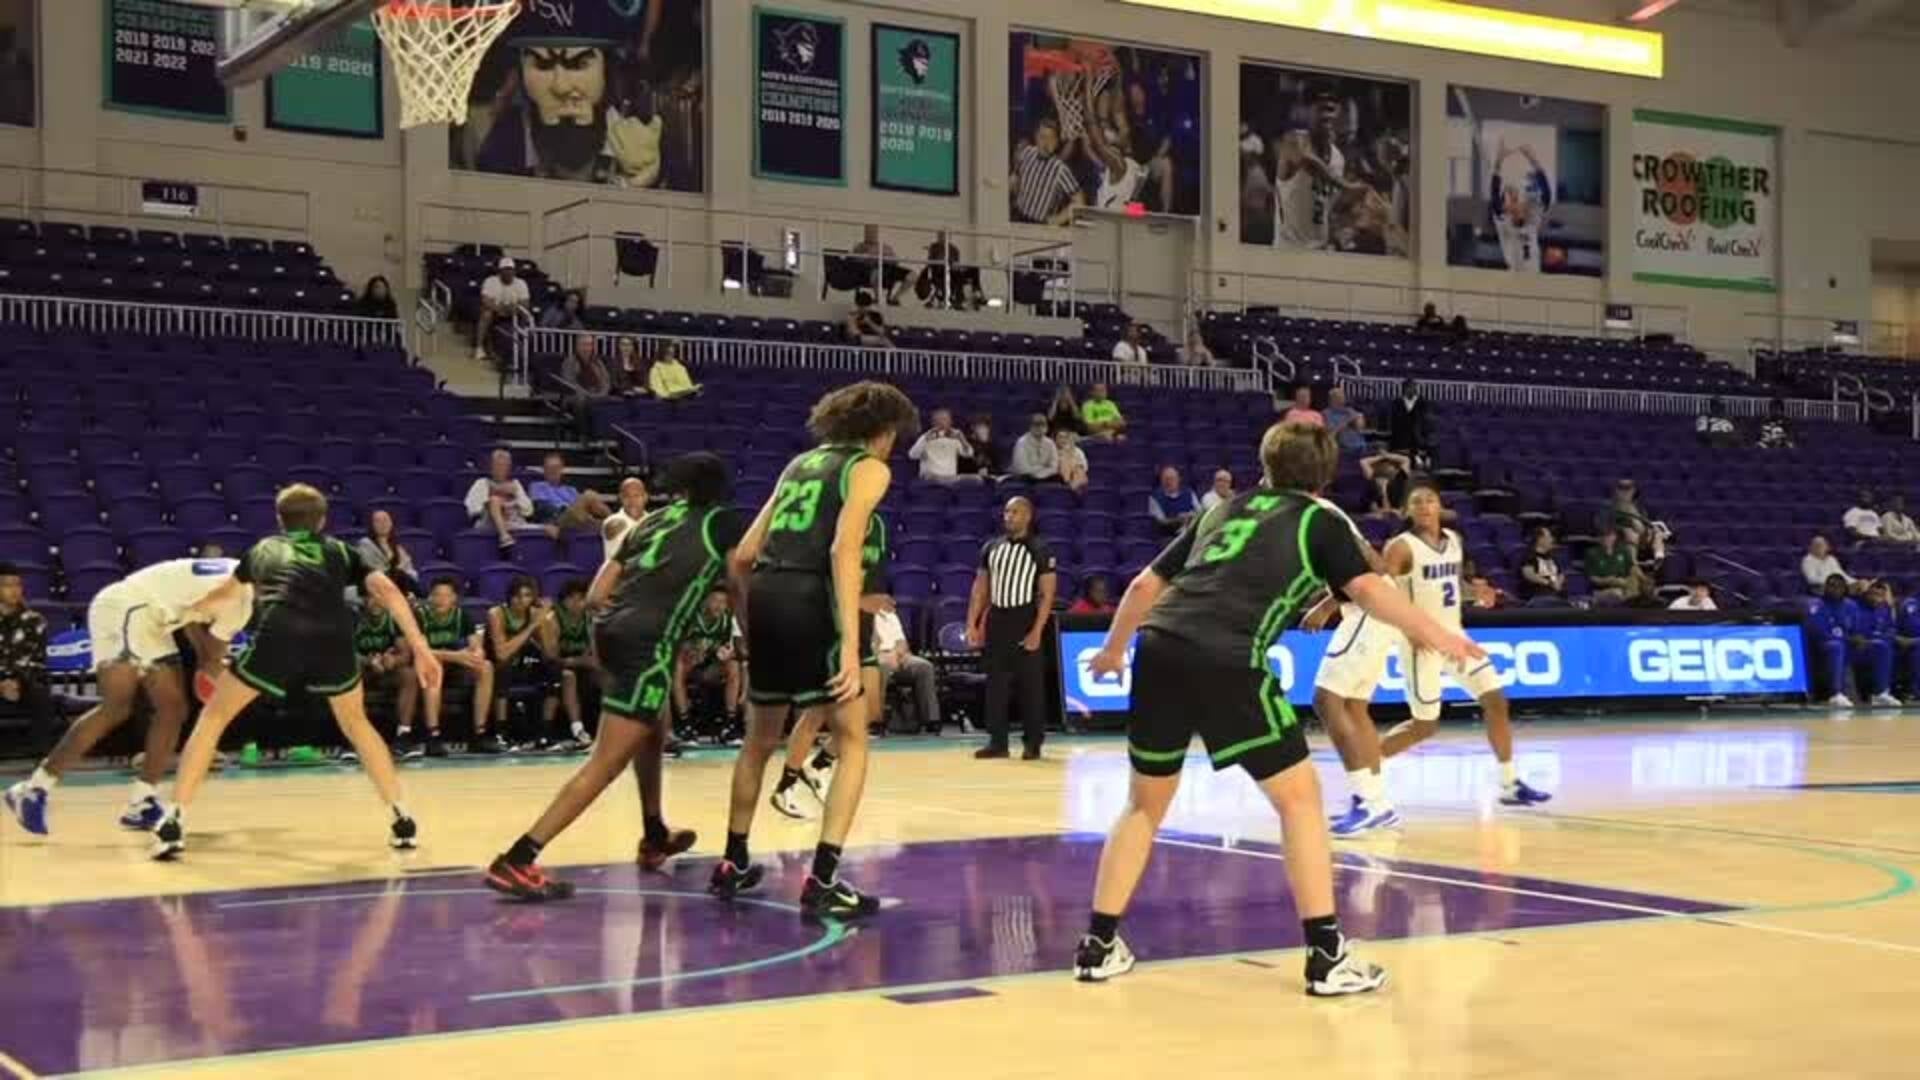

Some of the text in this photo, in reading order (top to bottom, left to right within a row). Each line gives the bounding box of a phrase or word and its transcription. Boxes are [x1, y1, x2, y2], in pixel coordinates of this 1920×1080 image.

[115, 47, 187, 71] 2021 2022
[191, 39, 216, 56] 202
[327, 57, 373, 77] 2020
[1632, 153, 1769, 196] CROWTHER
[1641, 188, 1757, 226] ROOFING
[769, 480, 824, 531] 23
[1442, 581, 1456, 608] 2
[1628, 637, 1794, 683] GEICO
